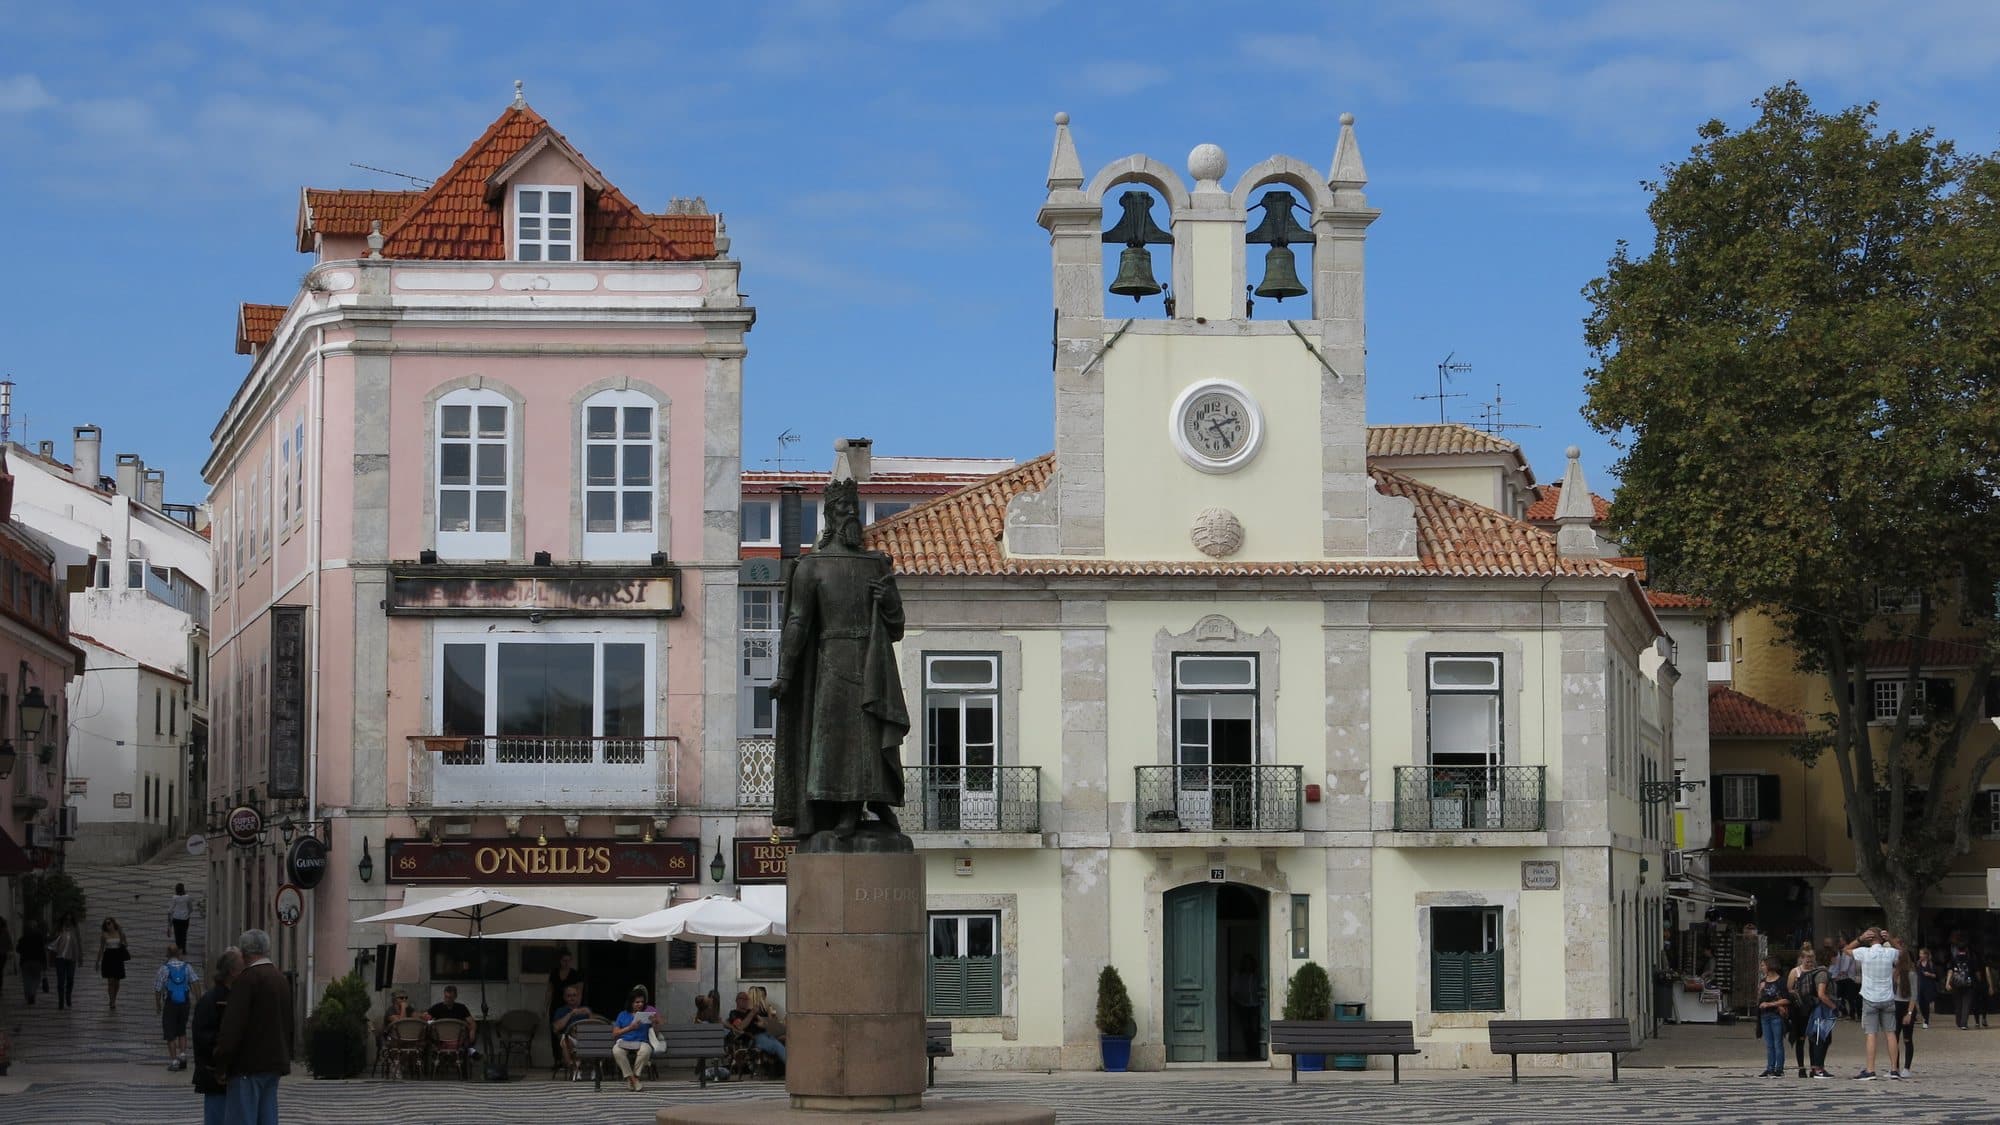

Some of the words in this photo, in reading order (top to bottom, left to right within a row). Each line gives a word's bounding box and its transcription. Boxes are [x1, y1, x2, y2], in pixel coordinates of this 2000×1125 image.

[1211, 401, 1221, 412] 12
[753, 845, 797, 860] IRISH
[400, 856, 417, 870] 88
[474, 846, 612, 874] O'NEILL'S
[669, 856, 686, 869] 88
[1212, 870, 1223, 879] 75
